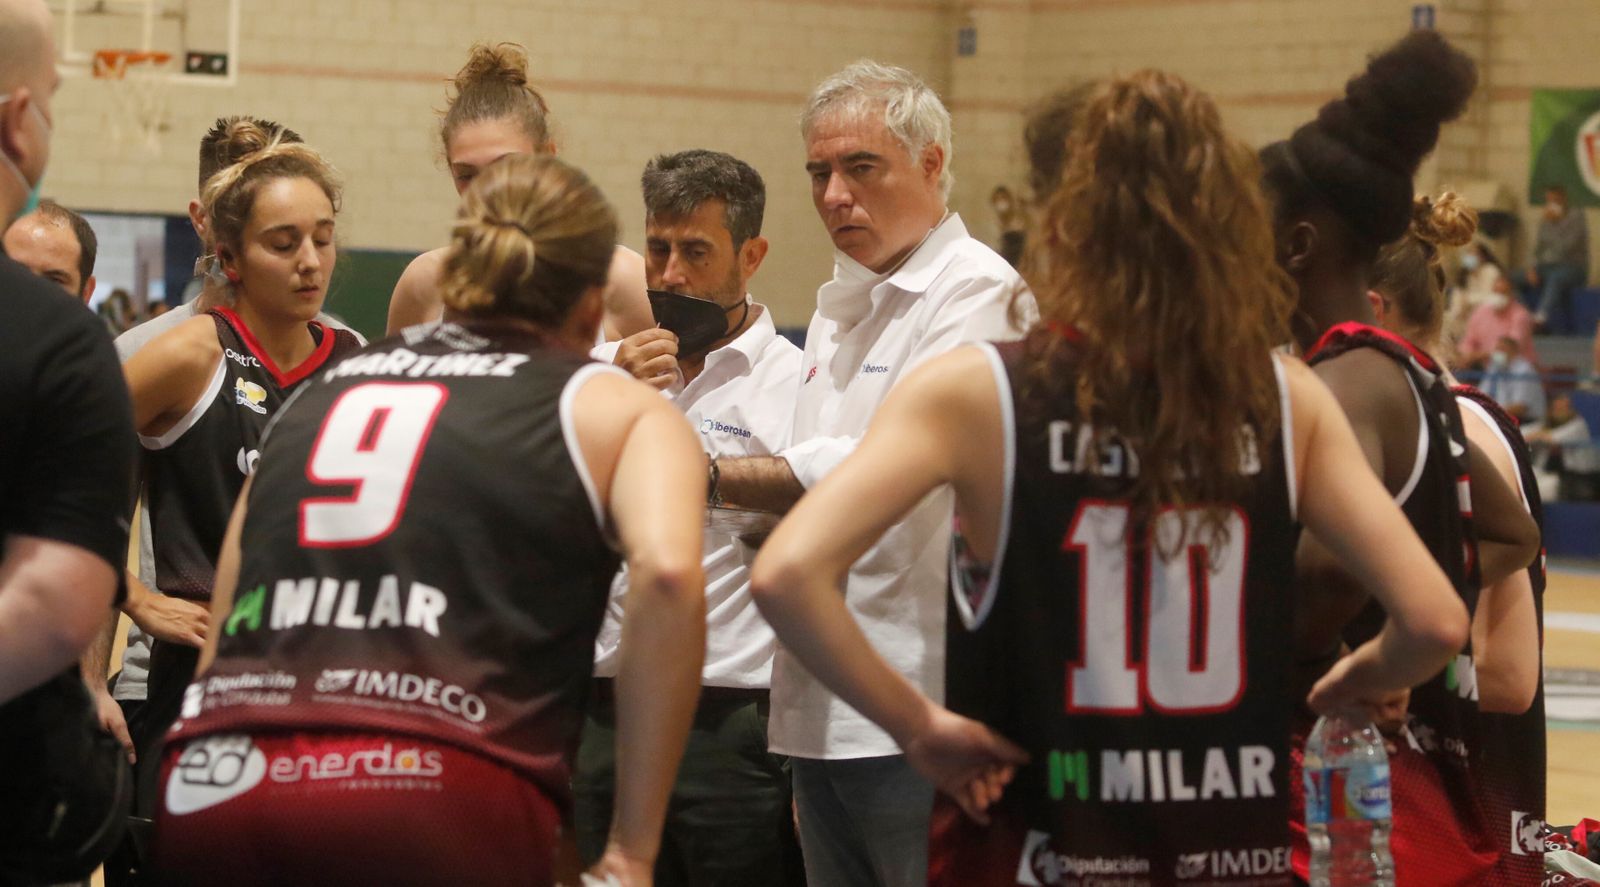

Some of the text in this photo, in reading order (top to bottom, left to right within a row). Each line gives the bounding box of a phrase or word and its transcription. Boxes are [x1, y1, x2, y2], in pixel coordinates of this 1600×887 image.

[323, 348, 530, 382] MARTINEZ
[714, 421, 751, 439] iberosan
[299, 380, 449, 548] 9
[269, 574, 447, 636] MILAR
[1062, 499, 1249, 714] 10
[355, 670, 487, 722] IMDECO
[1101, 746, 1275, 801] MILAR
